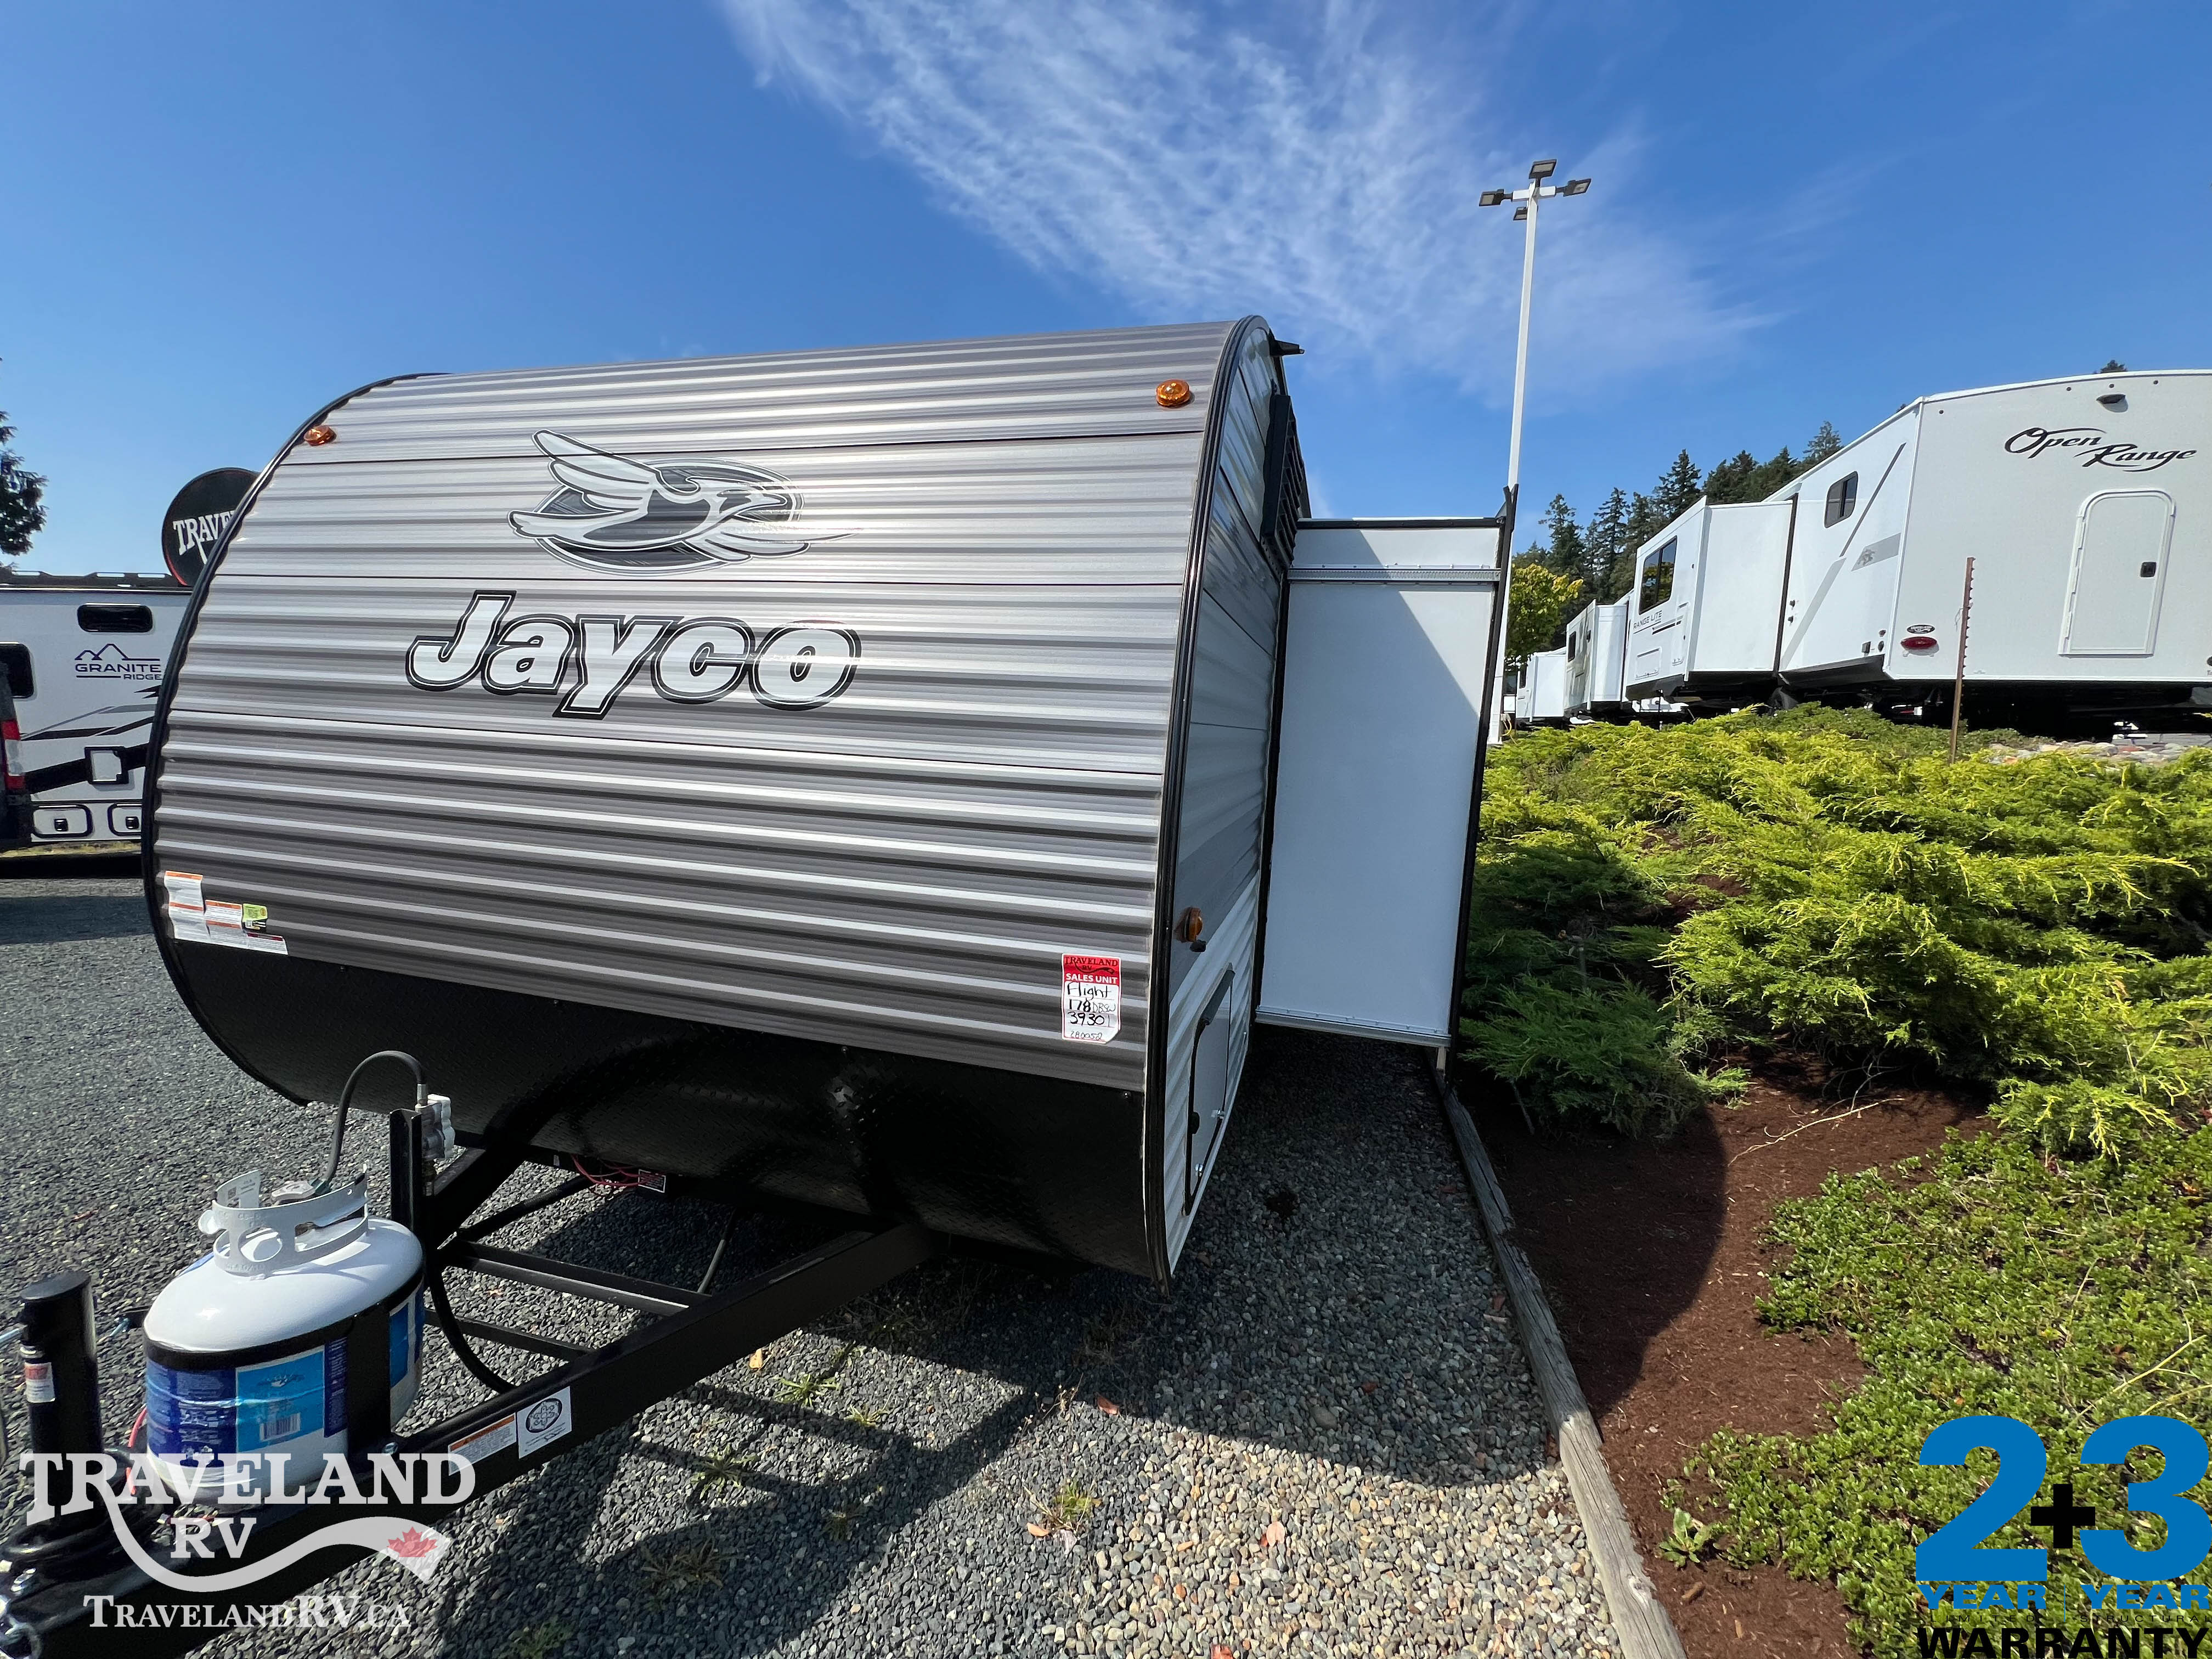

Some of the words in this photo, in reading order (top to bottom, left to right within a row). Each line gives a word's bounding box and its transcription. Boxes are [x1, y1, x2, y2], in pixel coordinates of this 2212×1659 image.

[2005, 427, 2107, 459] Open
[2073, 443, 2197, 472] Range
[173, 510, 235, 557] TRAVE
[1651, 610, 1662, 621] LITE
[405, 590, 862, 719] Jayco
[75, 664, 161, 672] GRANITE
[1064, 956, 1118, 967] TRAVELAND
[1066, 973, 1094, 982] SALES
